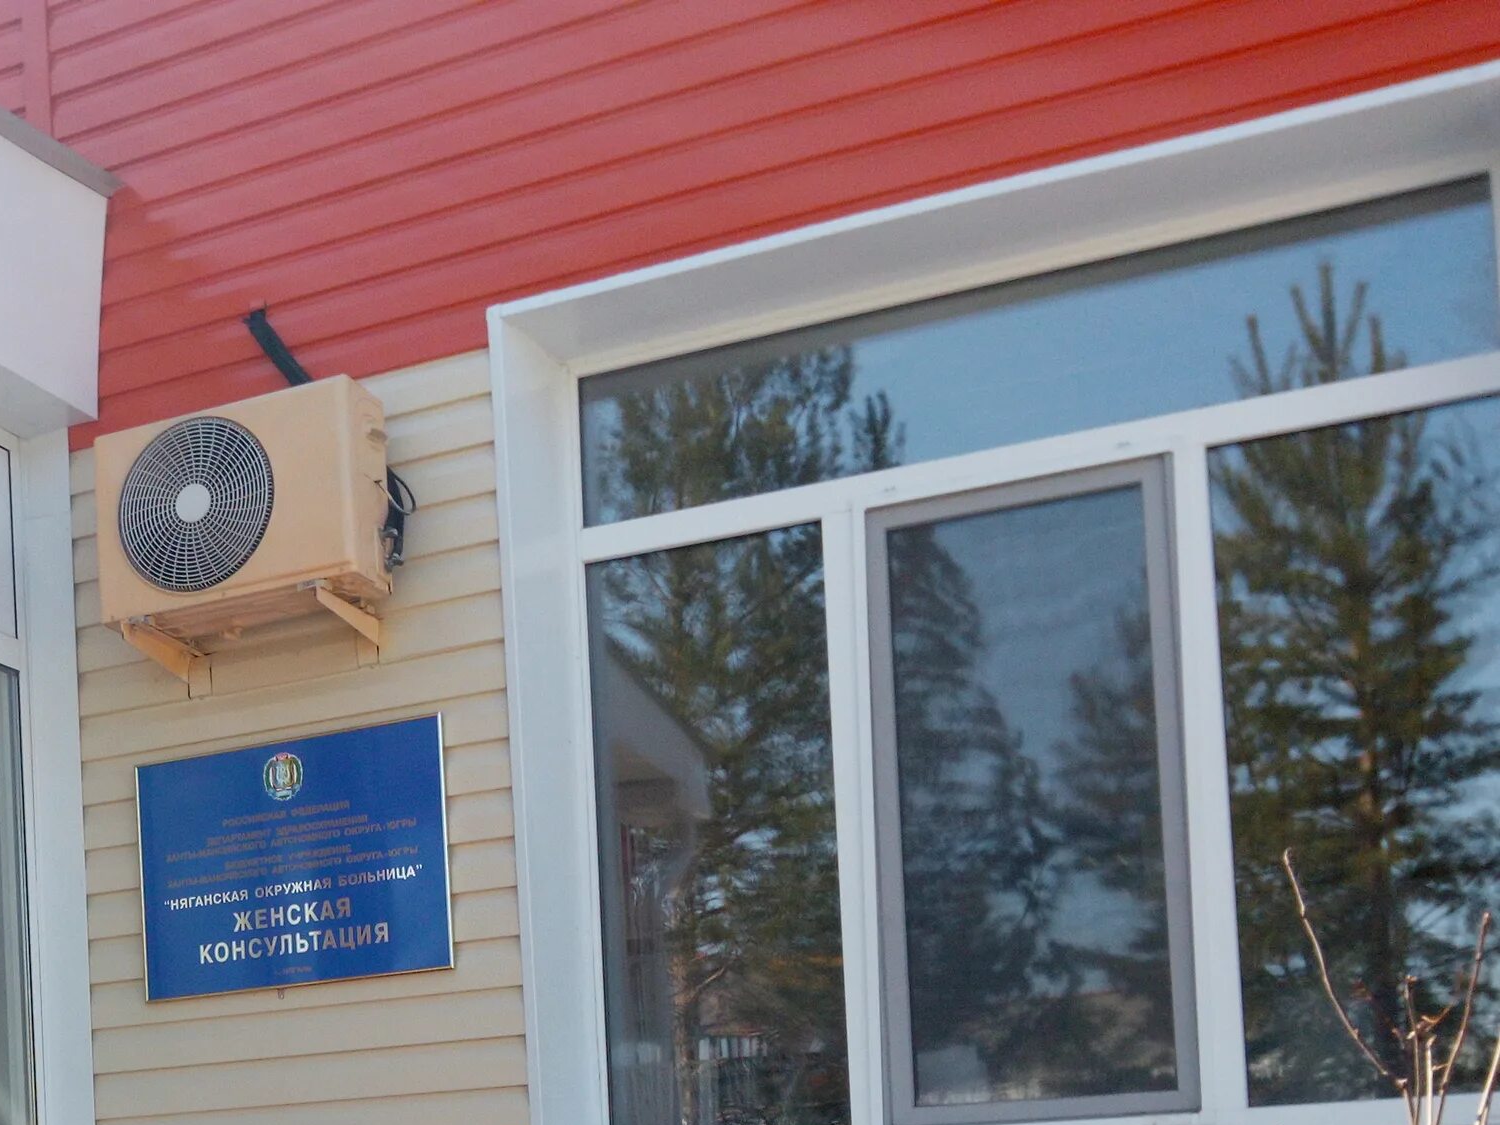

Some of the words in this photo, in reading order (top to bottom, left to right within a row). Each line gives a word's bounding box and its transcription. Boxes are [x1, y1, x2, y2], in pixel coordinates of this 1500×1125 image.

[255, 878, 332, 898] ОКРУЖНАЯ
[233, 897, 351, 932] ЖЕНСКАЯ
[199, 922, 389, 964] КОНСУЛЬТАЦИЯ
